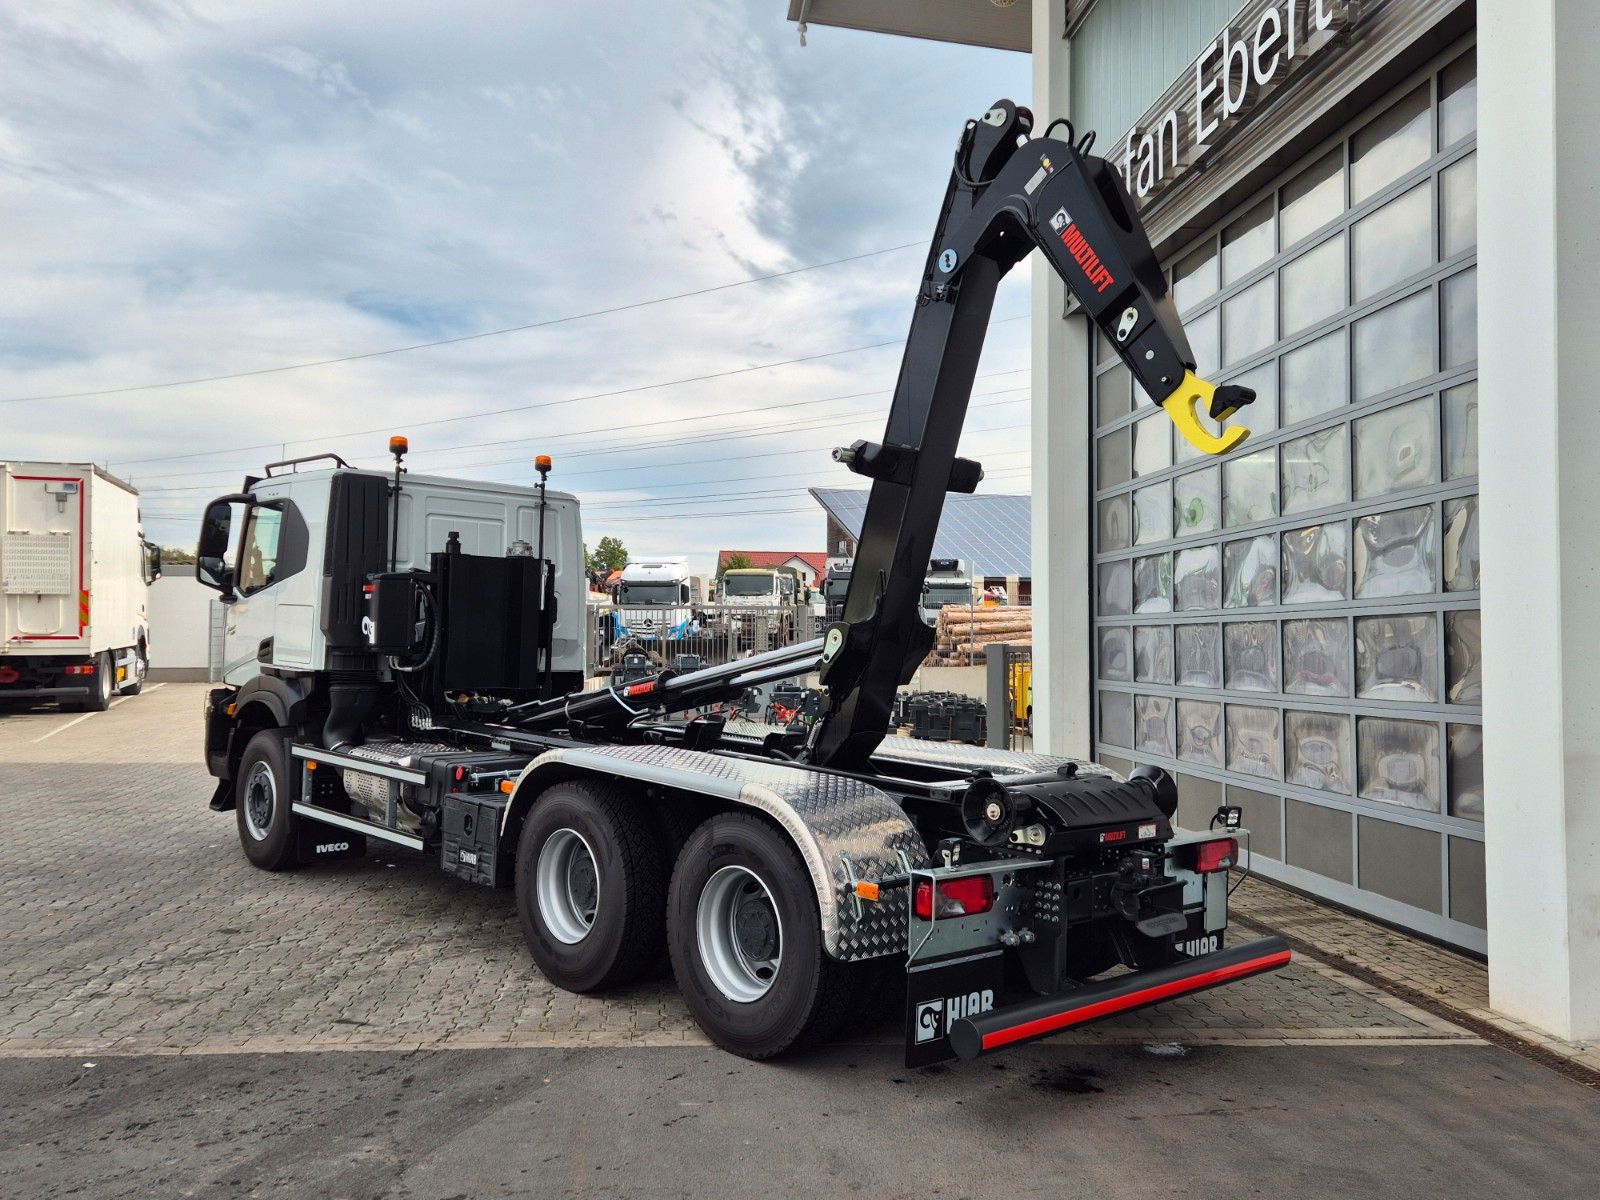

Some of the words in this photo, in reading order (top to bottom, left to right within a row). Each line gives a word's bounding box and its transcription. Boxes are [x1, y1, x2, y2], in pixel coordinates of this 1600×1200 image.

[1115, 111, 1177, 198] fan
[1060, 223, 1114, 292] MULTILIFT
[316, 842, 349, 854] IVECO
